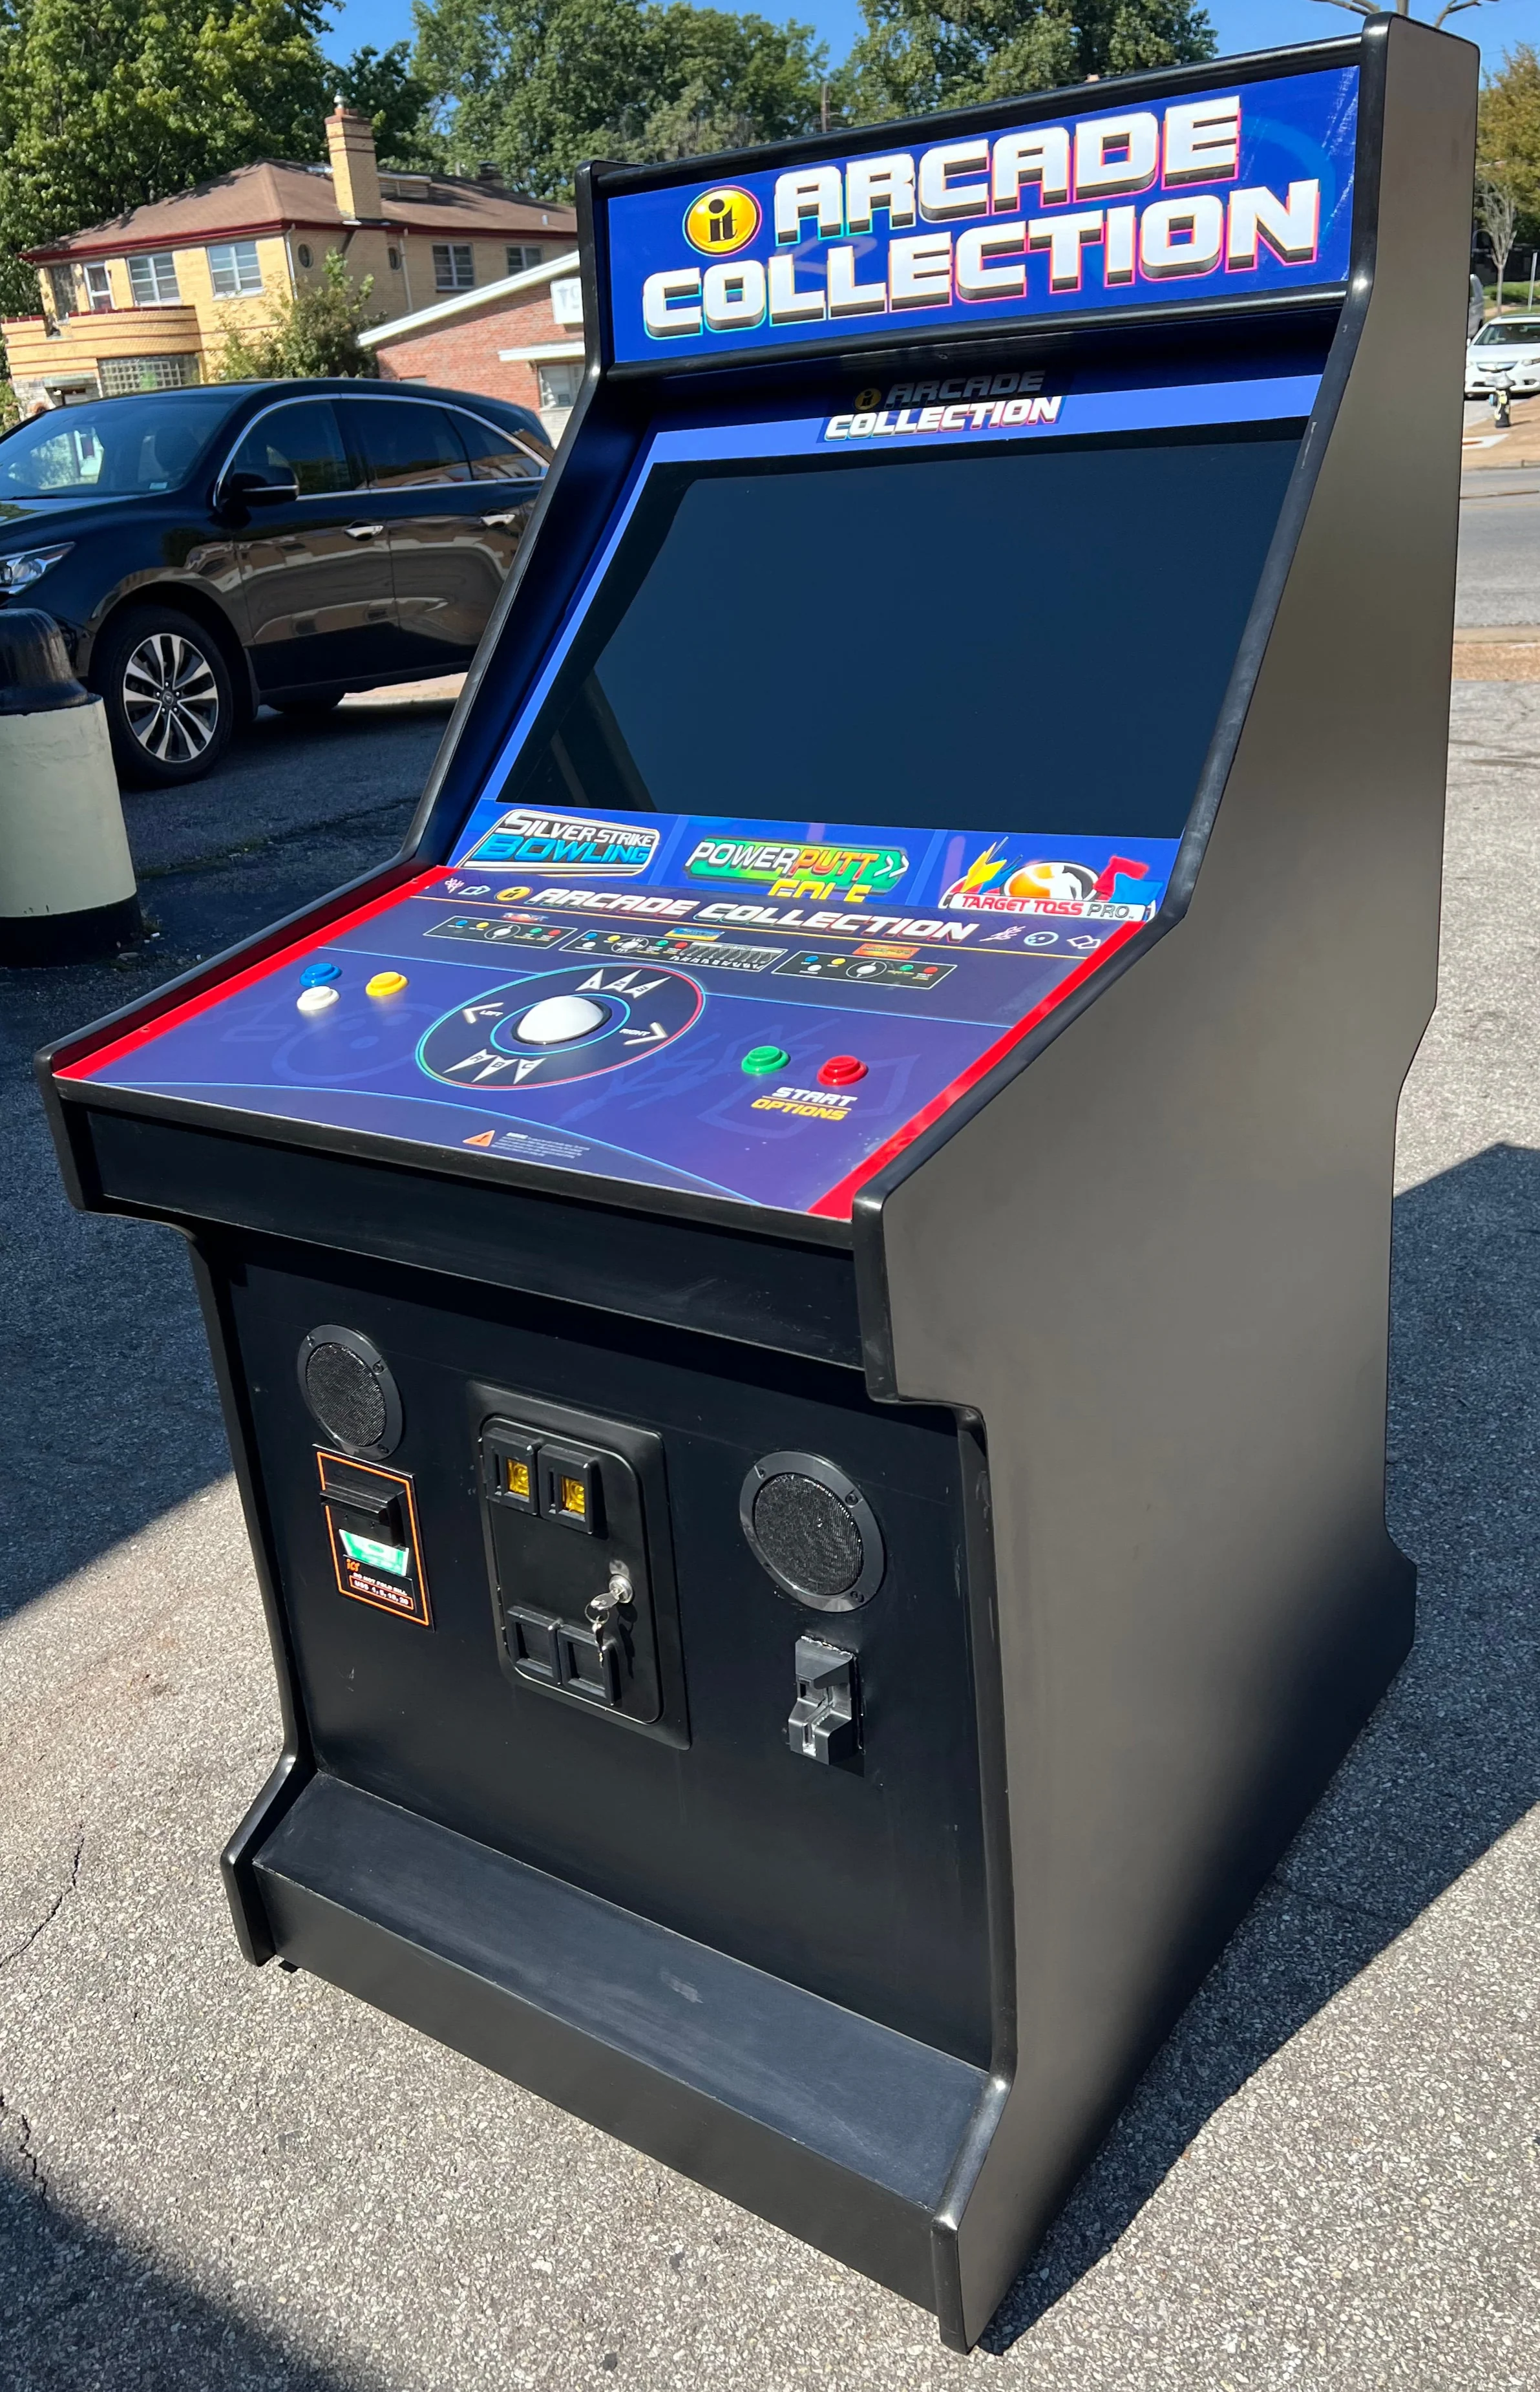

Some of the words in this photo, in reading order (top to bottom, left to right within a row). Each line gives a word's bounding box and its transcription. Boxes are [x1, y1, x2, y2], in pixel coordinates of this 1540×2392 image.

[775, 96, 1239, 244] ARCADE
[642, 180, 1318, 337] COLLECTION
[885, 370, 1045, 408] ARCADE
[825, 396, 1062, 441] COLLECTION
[496, 812, 597, 841] SILVER
[598, 829, 655, 847] STRIKE
[472, 834, 651, 863] BOWLING
[531, 888, 701, 919] ARCADE
[694, 902, 977, 944] COLLECTION
[962, 895, 1030, 913] TARGET
[1033, 901, 1084, 915] TOSS
[1087, 904, 1128, 919] PRO
[479, 1008, 503, 1017] LEFT
[750, 1098, 848, 1121] OPTIONS
[772, 1086, 858, 1106] START
